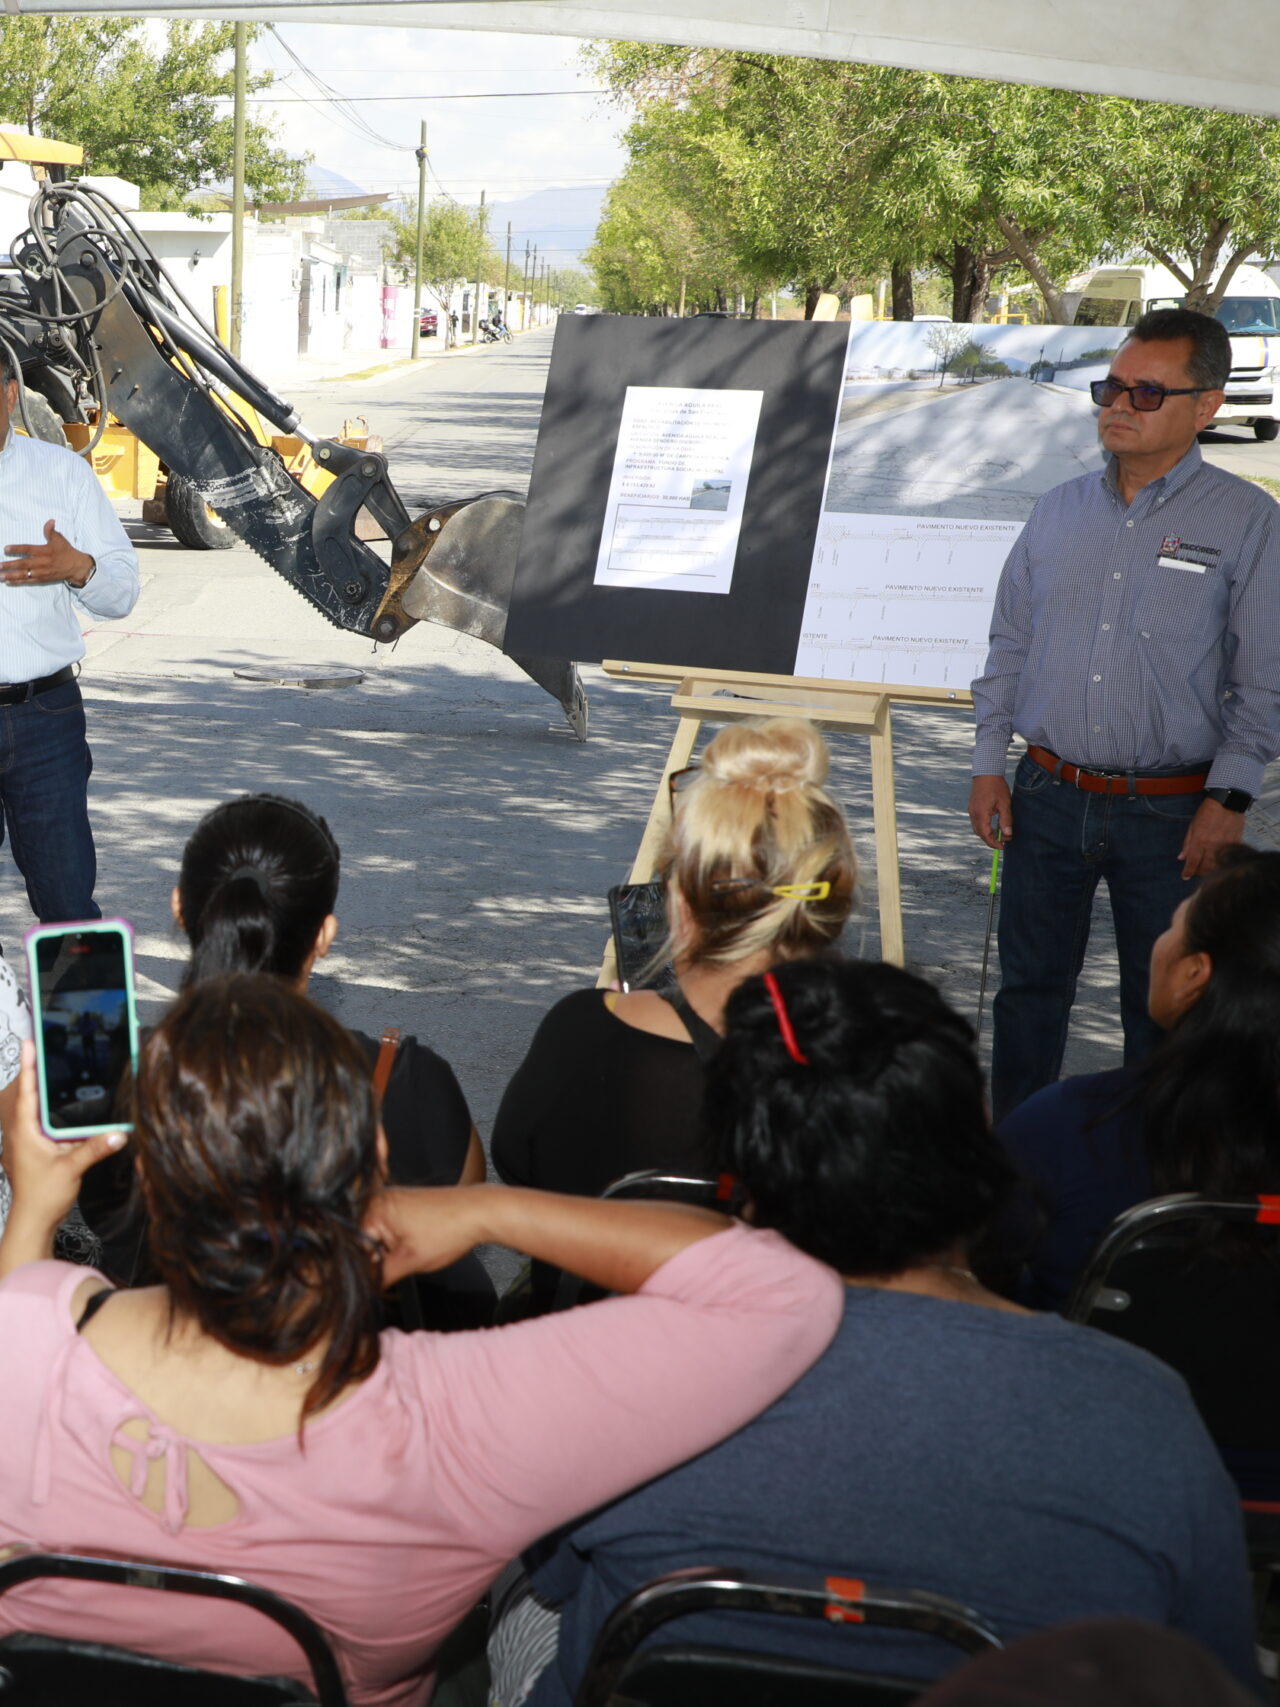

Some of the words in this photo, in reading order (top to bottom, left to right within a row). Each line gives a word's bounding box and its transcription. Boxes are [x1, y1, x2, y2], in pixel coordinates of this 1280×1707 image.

[885, 584, 922, 592] PAVIMENTO
[910, 636, 933, 644] NUEVO
[934, 637, 969, 645] EXISTENTE
